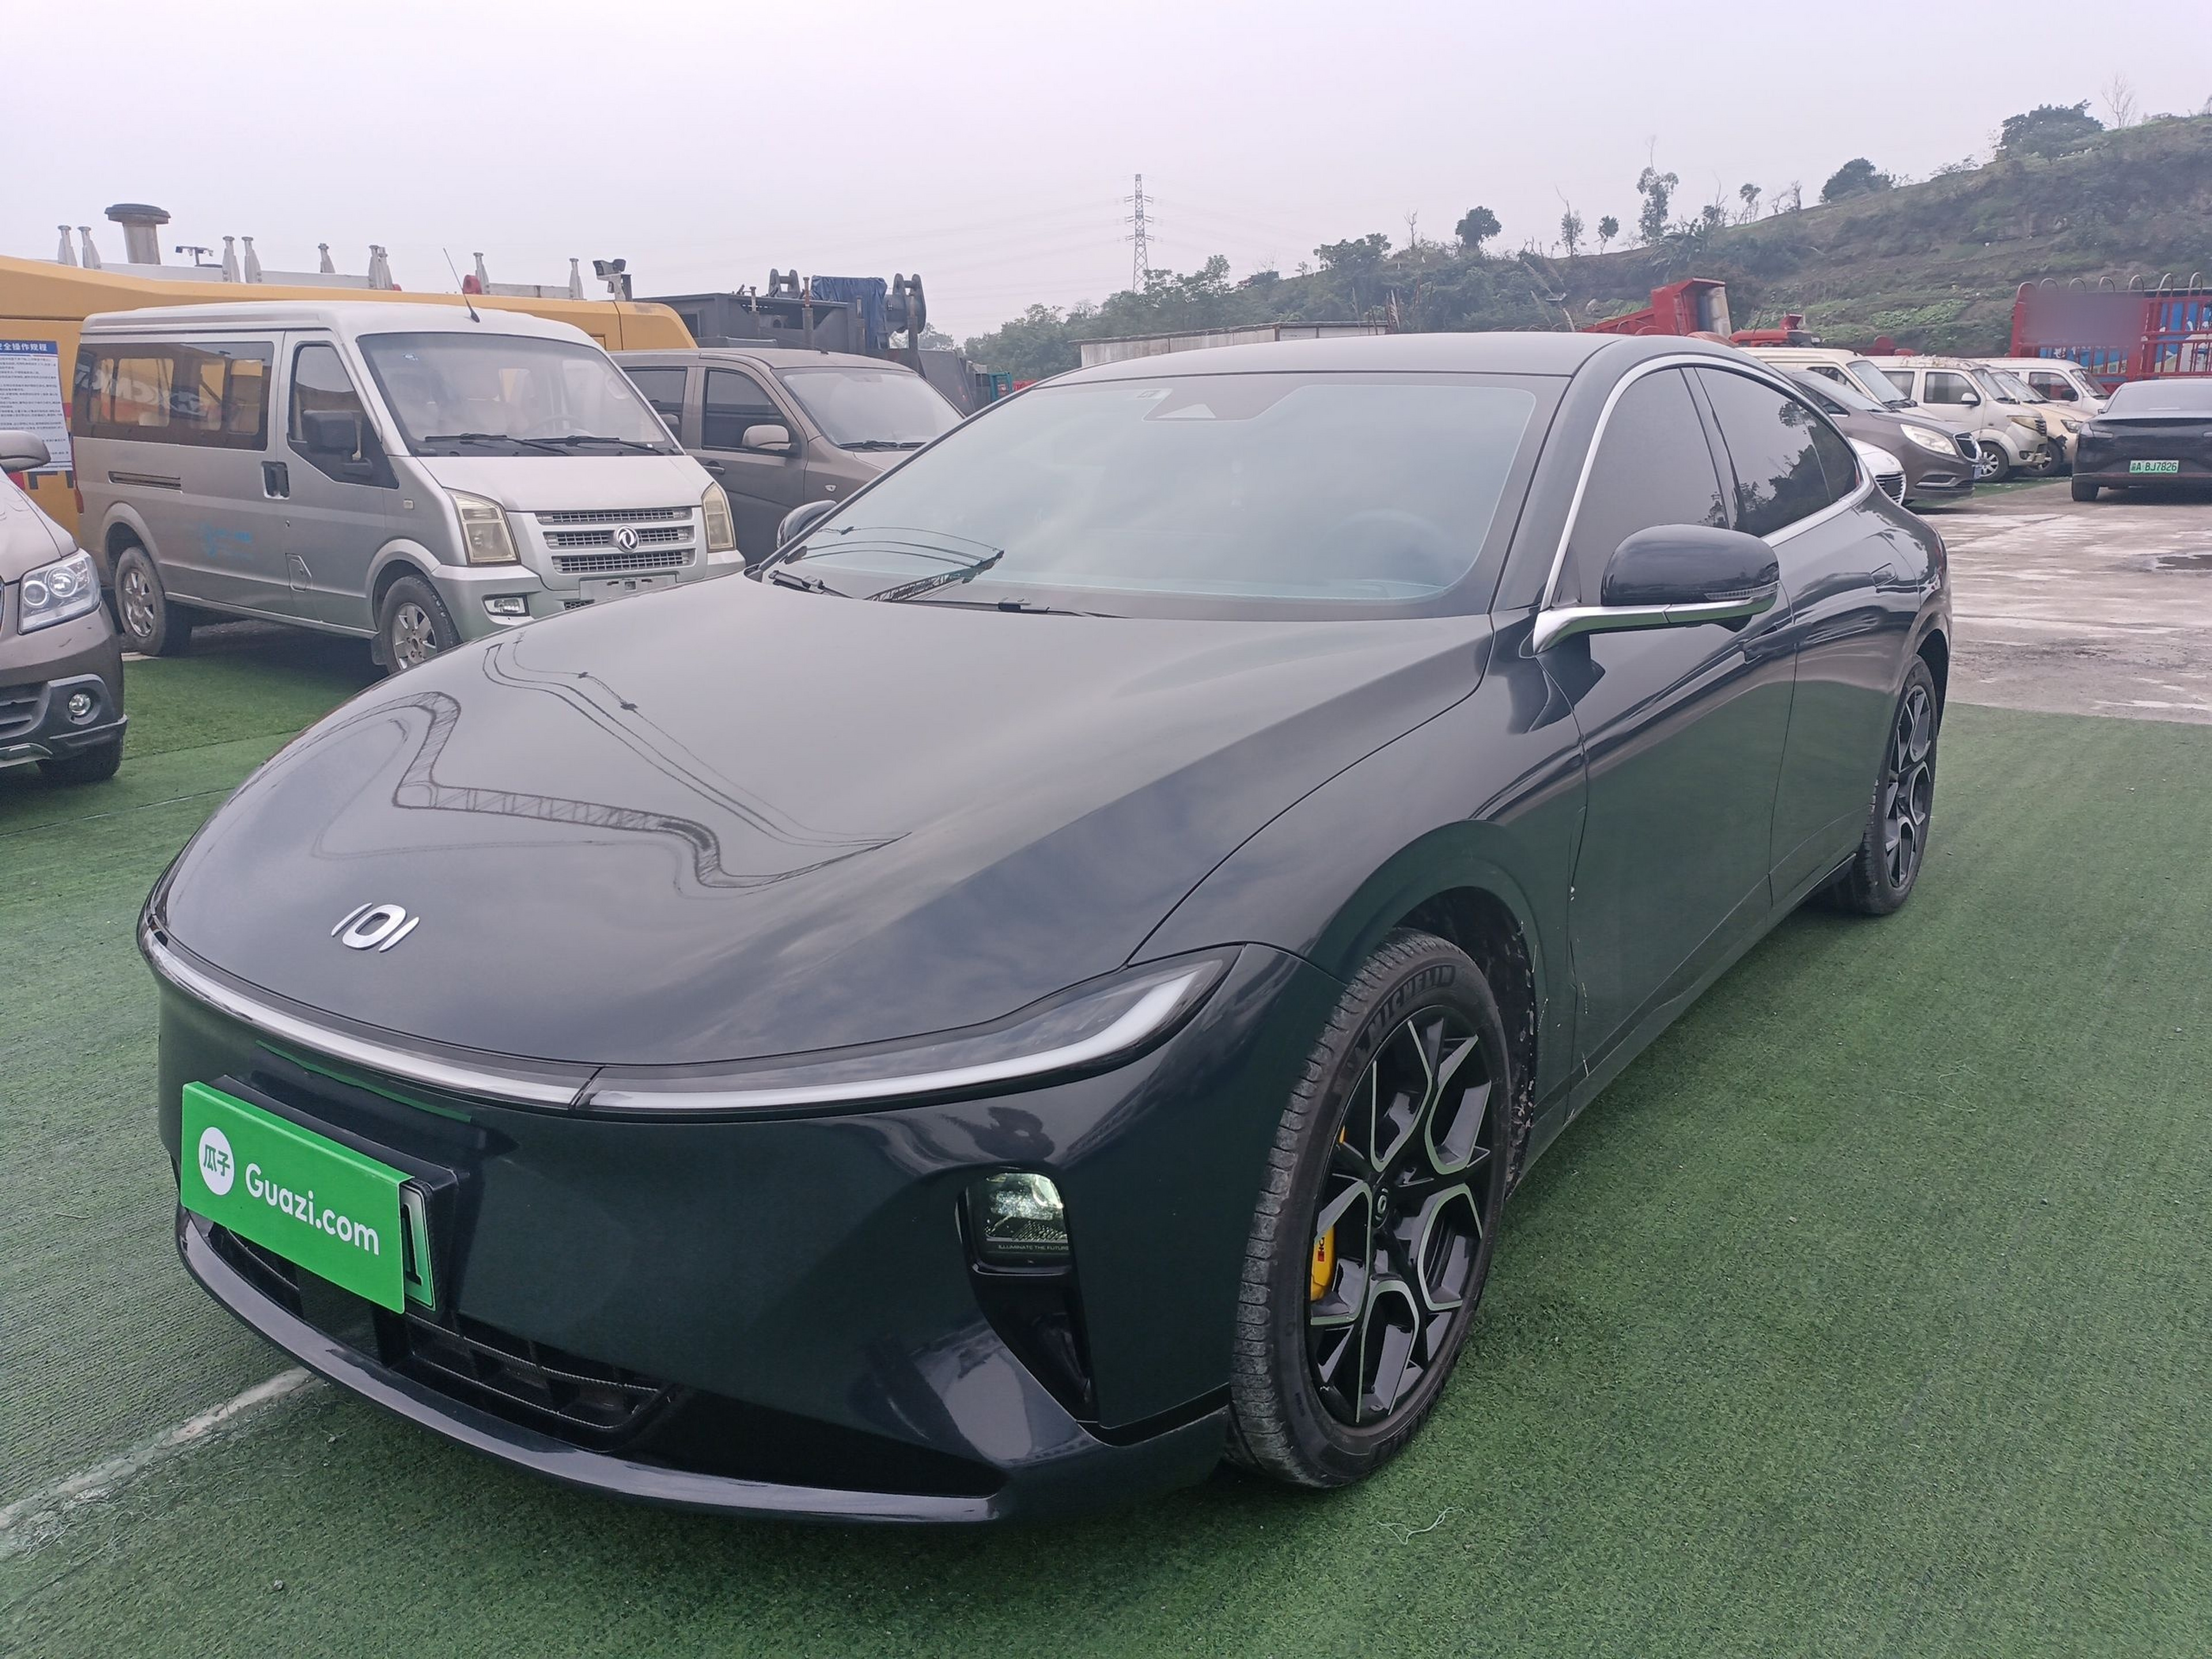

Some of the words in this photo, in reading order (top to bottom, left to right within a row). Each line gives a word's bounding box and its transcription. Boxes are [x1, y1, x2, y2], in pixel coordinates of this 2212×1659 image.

[1368, 966, 1454, 1039] MICHELIN
[203, 1143, 231, 1177] 瓜子
[245, 1162, 380, 1256] Guazi.com
